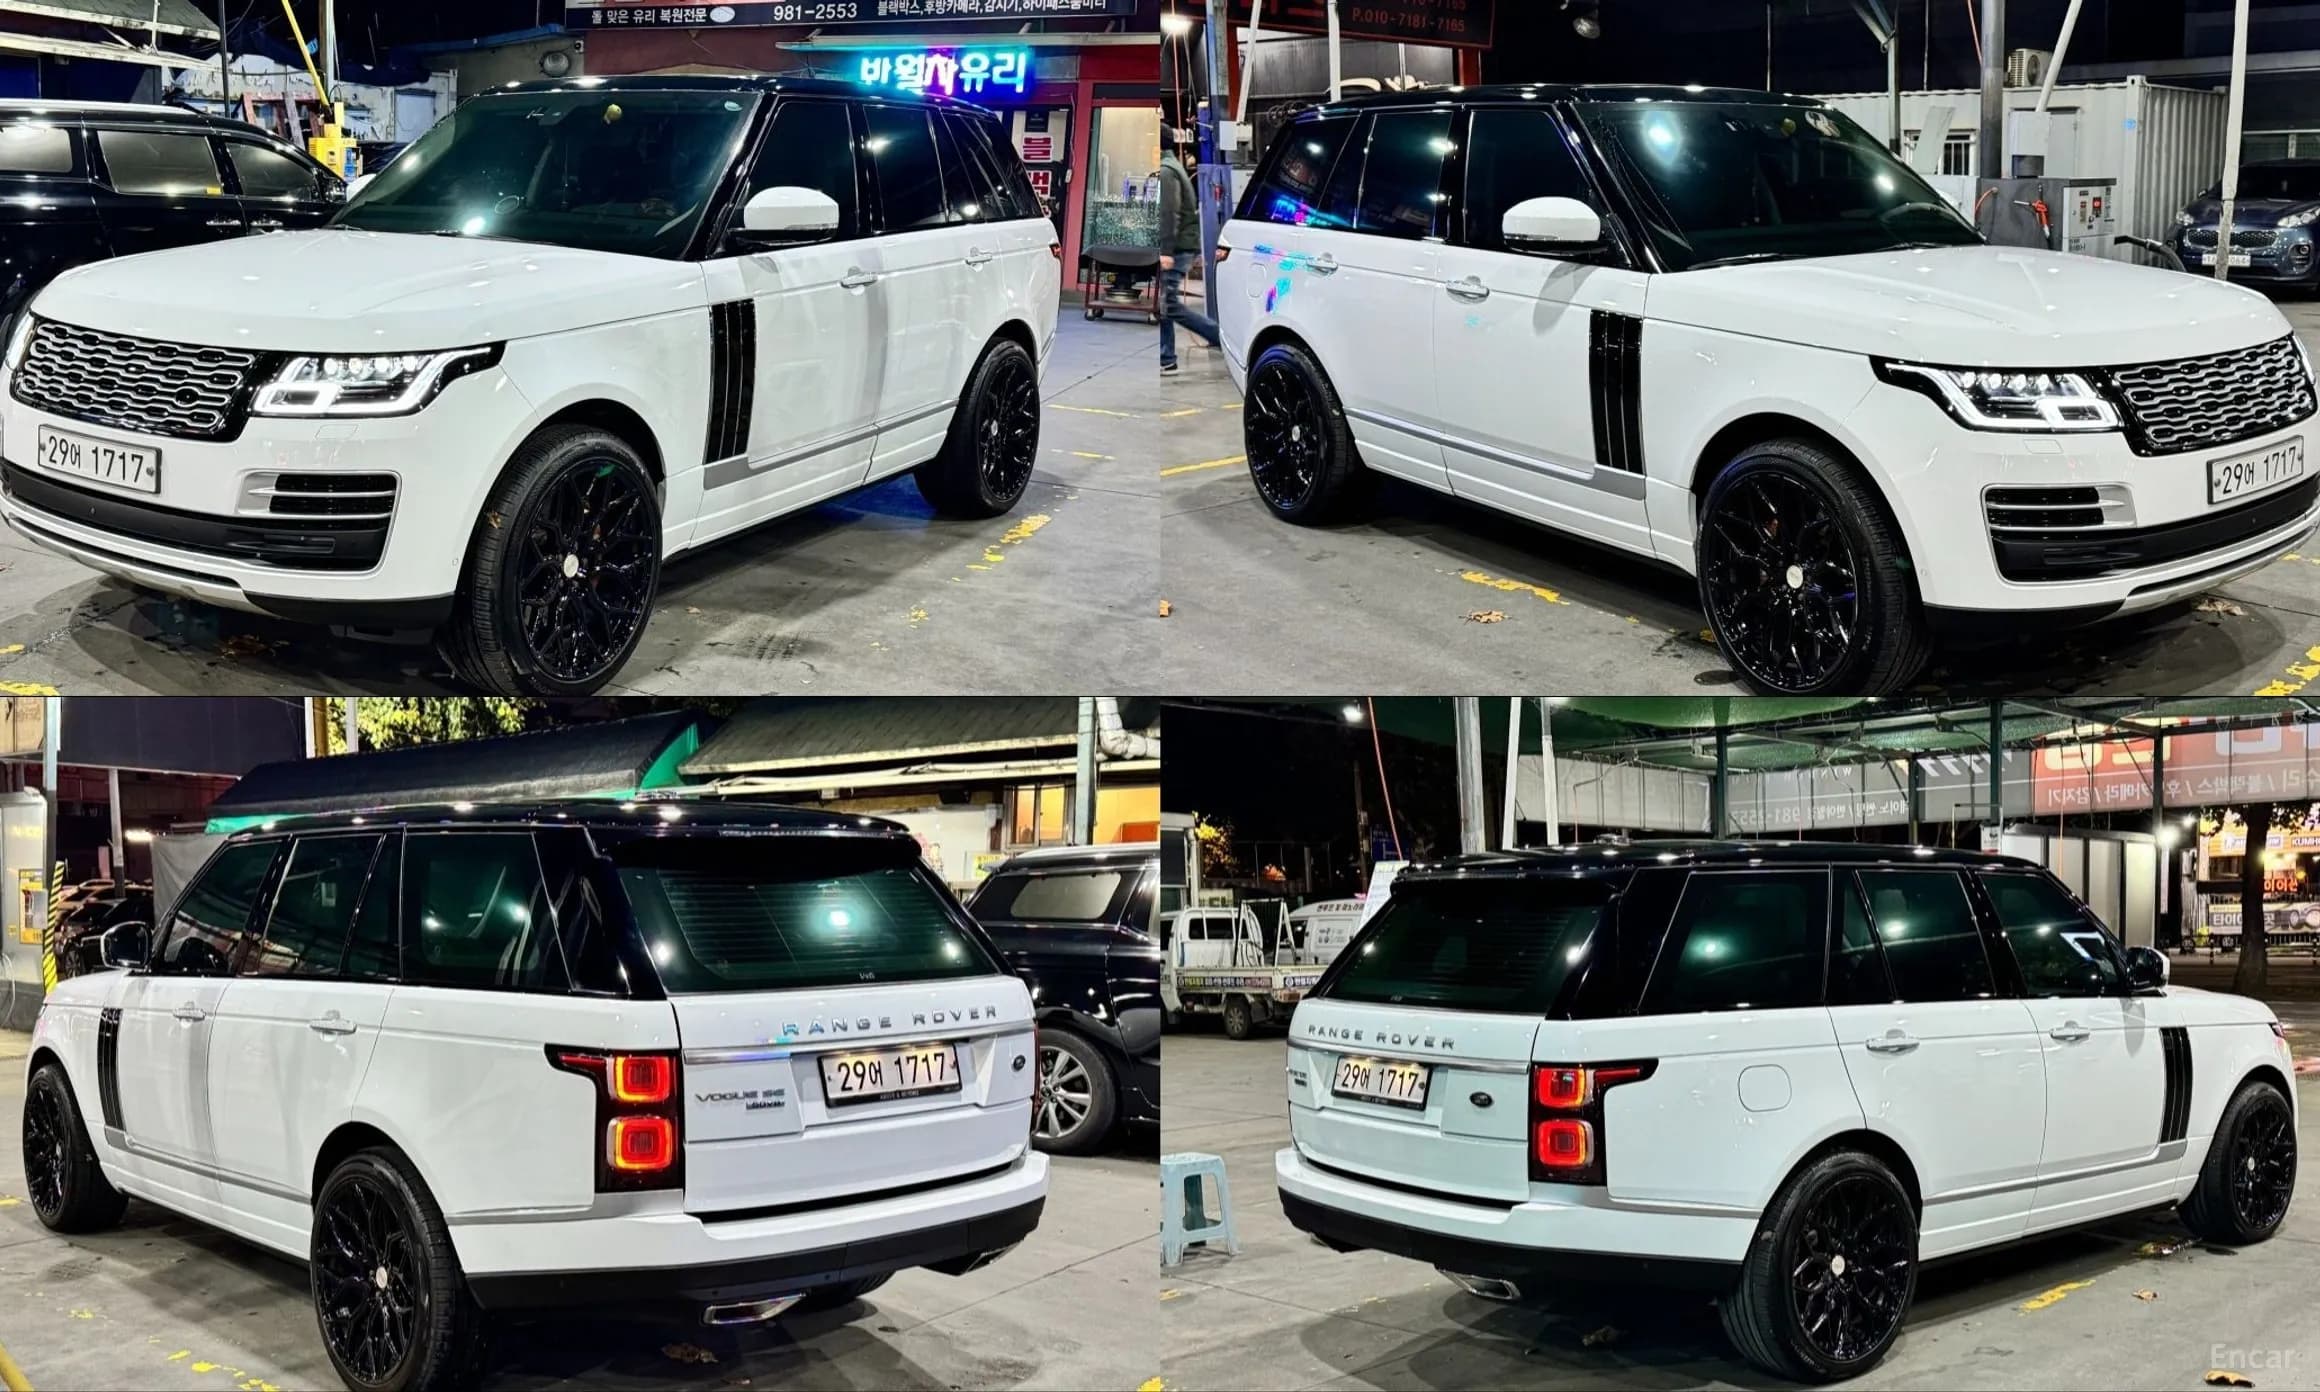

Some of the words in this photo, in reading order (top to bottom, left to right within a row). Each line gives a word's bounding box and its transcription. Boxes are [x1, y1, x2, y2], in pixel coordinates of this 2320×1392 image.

[633, 9, 655, 24] 유리
[660, 7, 707, 24] 복원전문
[773, 3, 857, 21] 981-2553
[49, 434, 82, 467] 29어
[91, 446, 144, 483] 1717
[2222, 462, 2255, 495] 29어
[2263, 446, 2297, 482] 1717
[782, 1016, 892, 1036] RANGE
[913, 1006, 998, 1025] ROVER
[1308, 1025, 1364, 1041] RANGE
[1376, 1032, 1457, 1050] ROVER
[837, 1060, 883, 1092] 29어
[895, 1053, 947, 1086] 1717
[1341, 1063, 1371, 1090] 29어
[1378, 1068, 1420, 1098] 1717
[695, 1090, 758, 1103] VOGUE
